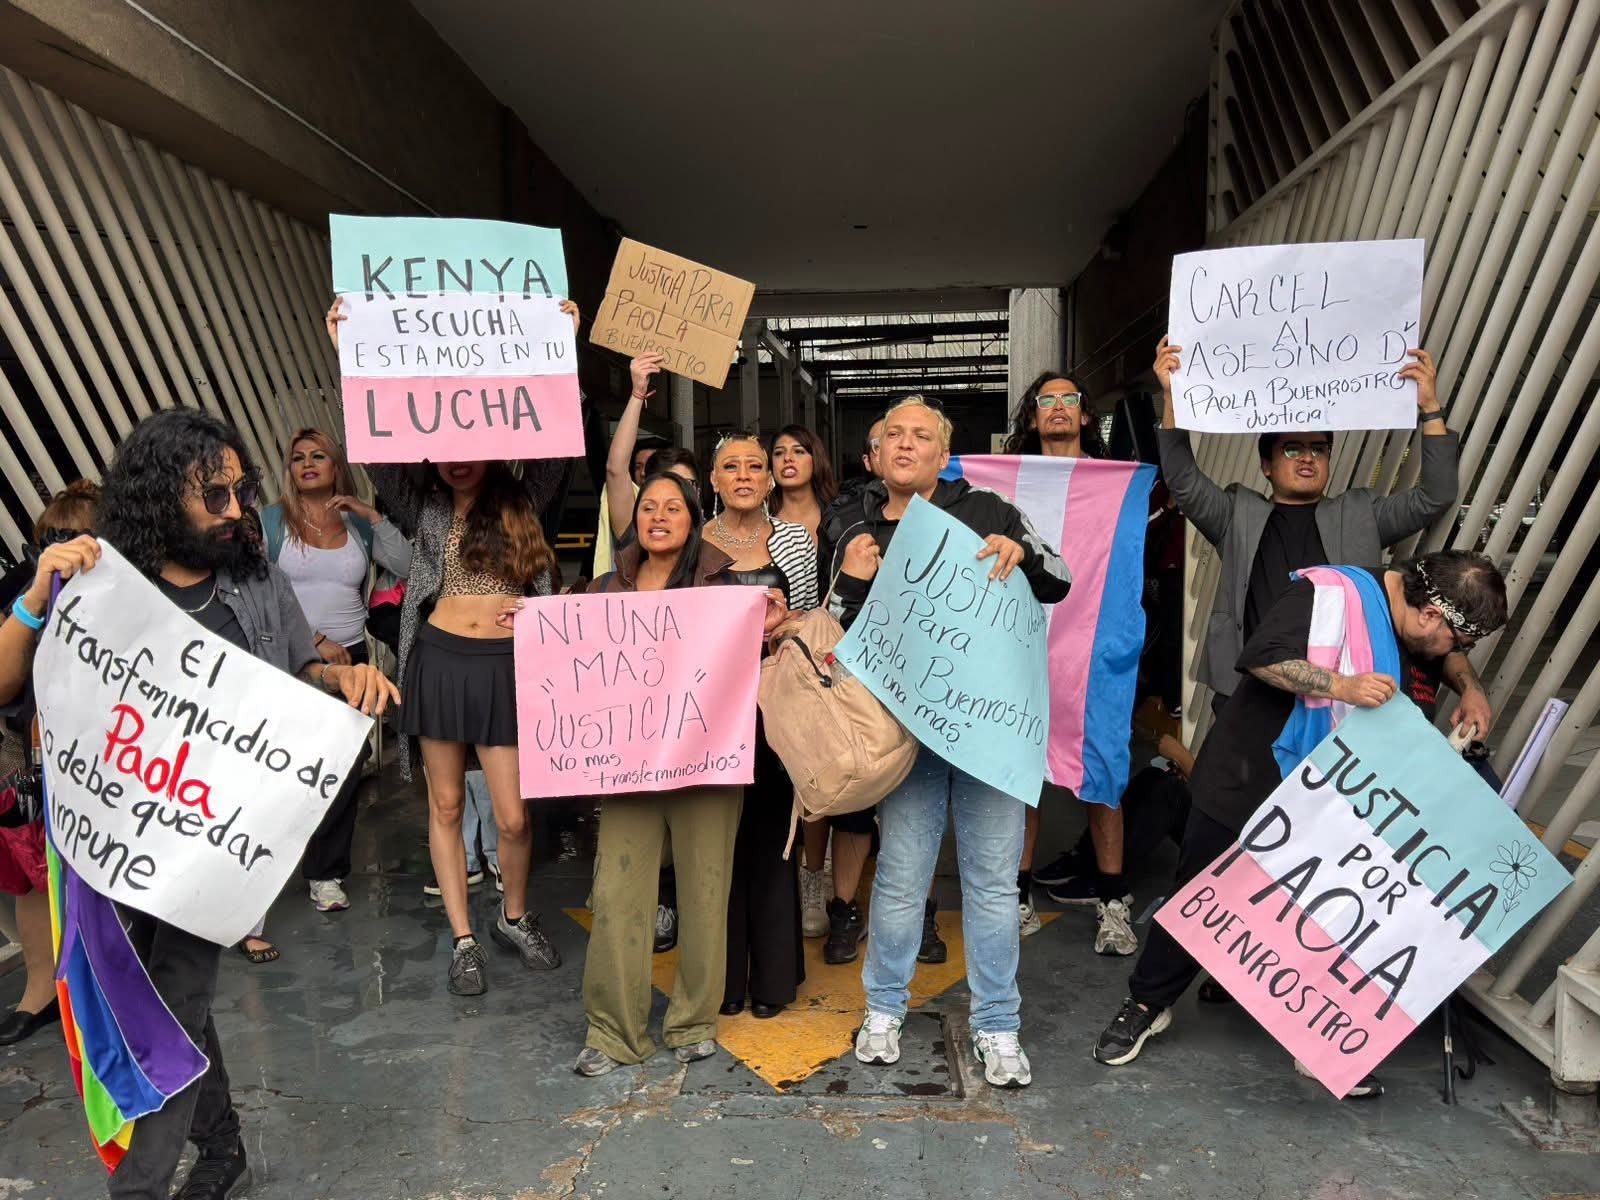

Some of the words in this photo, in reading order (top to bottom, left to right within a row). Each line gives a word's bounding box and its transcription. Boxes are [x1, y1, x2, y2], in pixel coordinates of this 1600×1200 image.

[361, 253, 553, 302] KENYA
[682, 269, 733, 328] PARA
[1190, 266, 1350, 323] CARCEL
[393, 308, 524, 337] ESCUCHA
[612, 289, 688, 342] PAOLA
[356, 341, 484, 368] ESTAMOS
[501, 341, 530, 364] EN
[544, 341, 565, 360] TU
[367, 386, 542, 437] LUCHA
[1183, 384, 1257, 418] PAOLA
[1266, 372, 1405, 406] BUENROSTRO
[606, 598, 682, 645] UNA
[899, 590, 972, 656] Para
[180, 640, 226, 689] El
[573, 647, 665, 693] MAS
[857, 600, 907, 675] Paola
[915, 656, 1043, 746] Buenrostro
[882, 673, 907, 706] una
[54, 595, 291, 772] transfeminicidio
[297, 757, 338, 799] de
[104, 703, 216, 819] Paola
[585, 752, 622, 767] mas
[58, 739, 123, 809] debe
[131, 800, 274, 872] quedar
[1300, 736, 1499, 940] JUSTICIA
[1338, 843, 1407, 915] POR
[1211, 805, 1418, 1021] PAOLA
[1180, 887, 1369, 1054] BUENROSTRO
